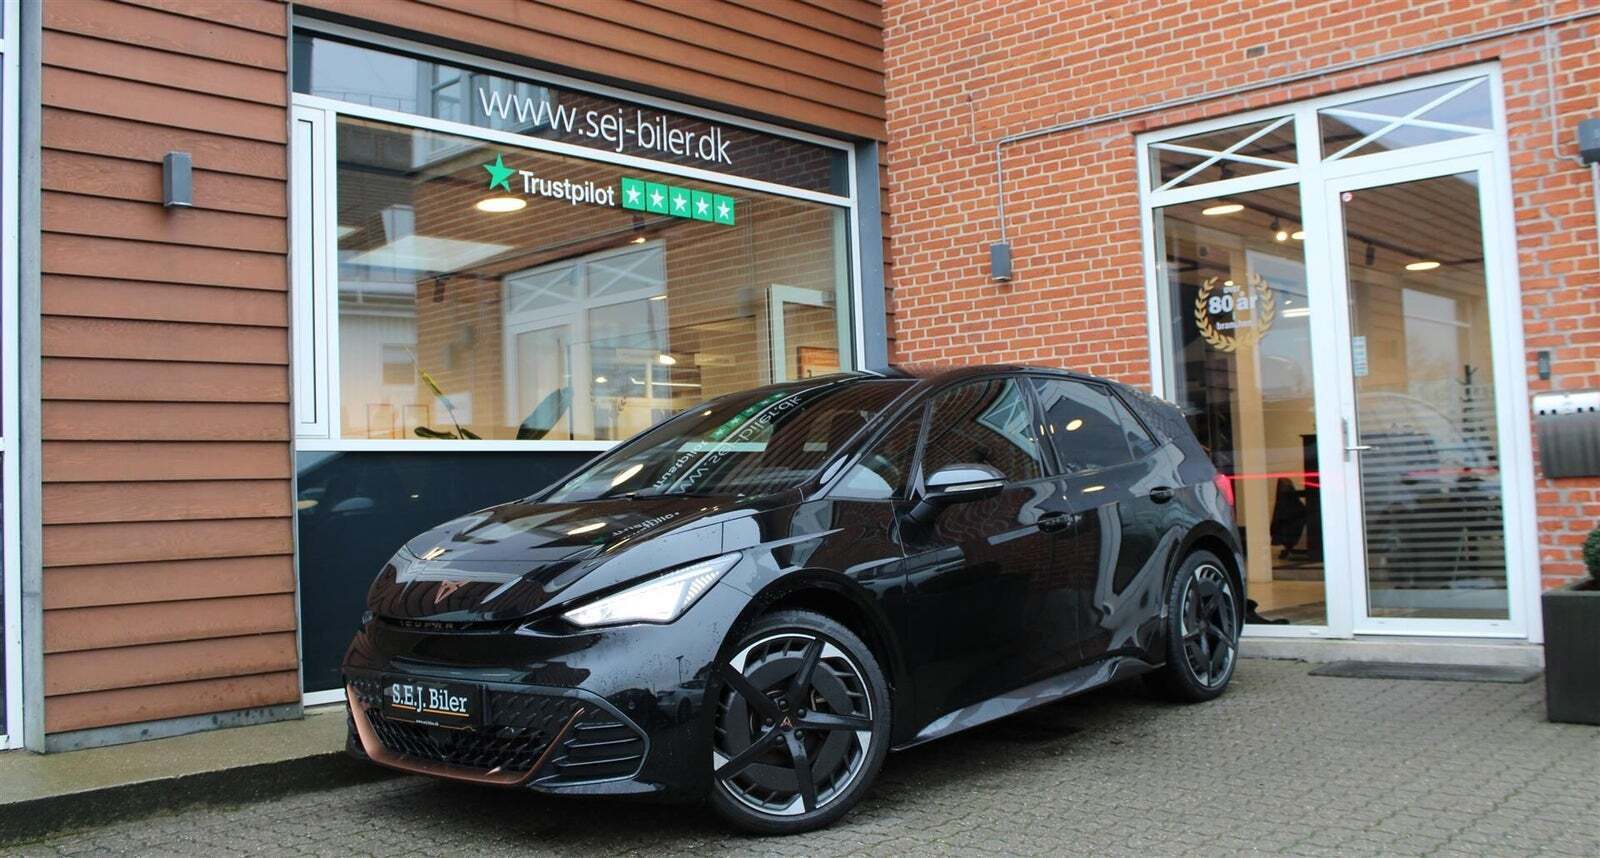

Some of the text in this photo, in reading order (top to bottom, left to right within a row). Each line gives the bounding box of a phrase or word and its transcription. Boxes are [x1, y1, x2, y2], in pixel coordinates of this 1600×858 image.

[479, 88, 732, 165] www.sej-biler.dk
[519, 170, 615, 207] Trustpilot
[1208, 295, 1233, 314] 80
[392, 683, 468, 712] S.E.J. Biler
